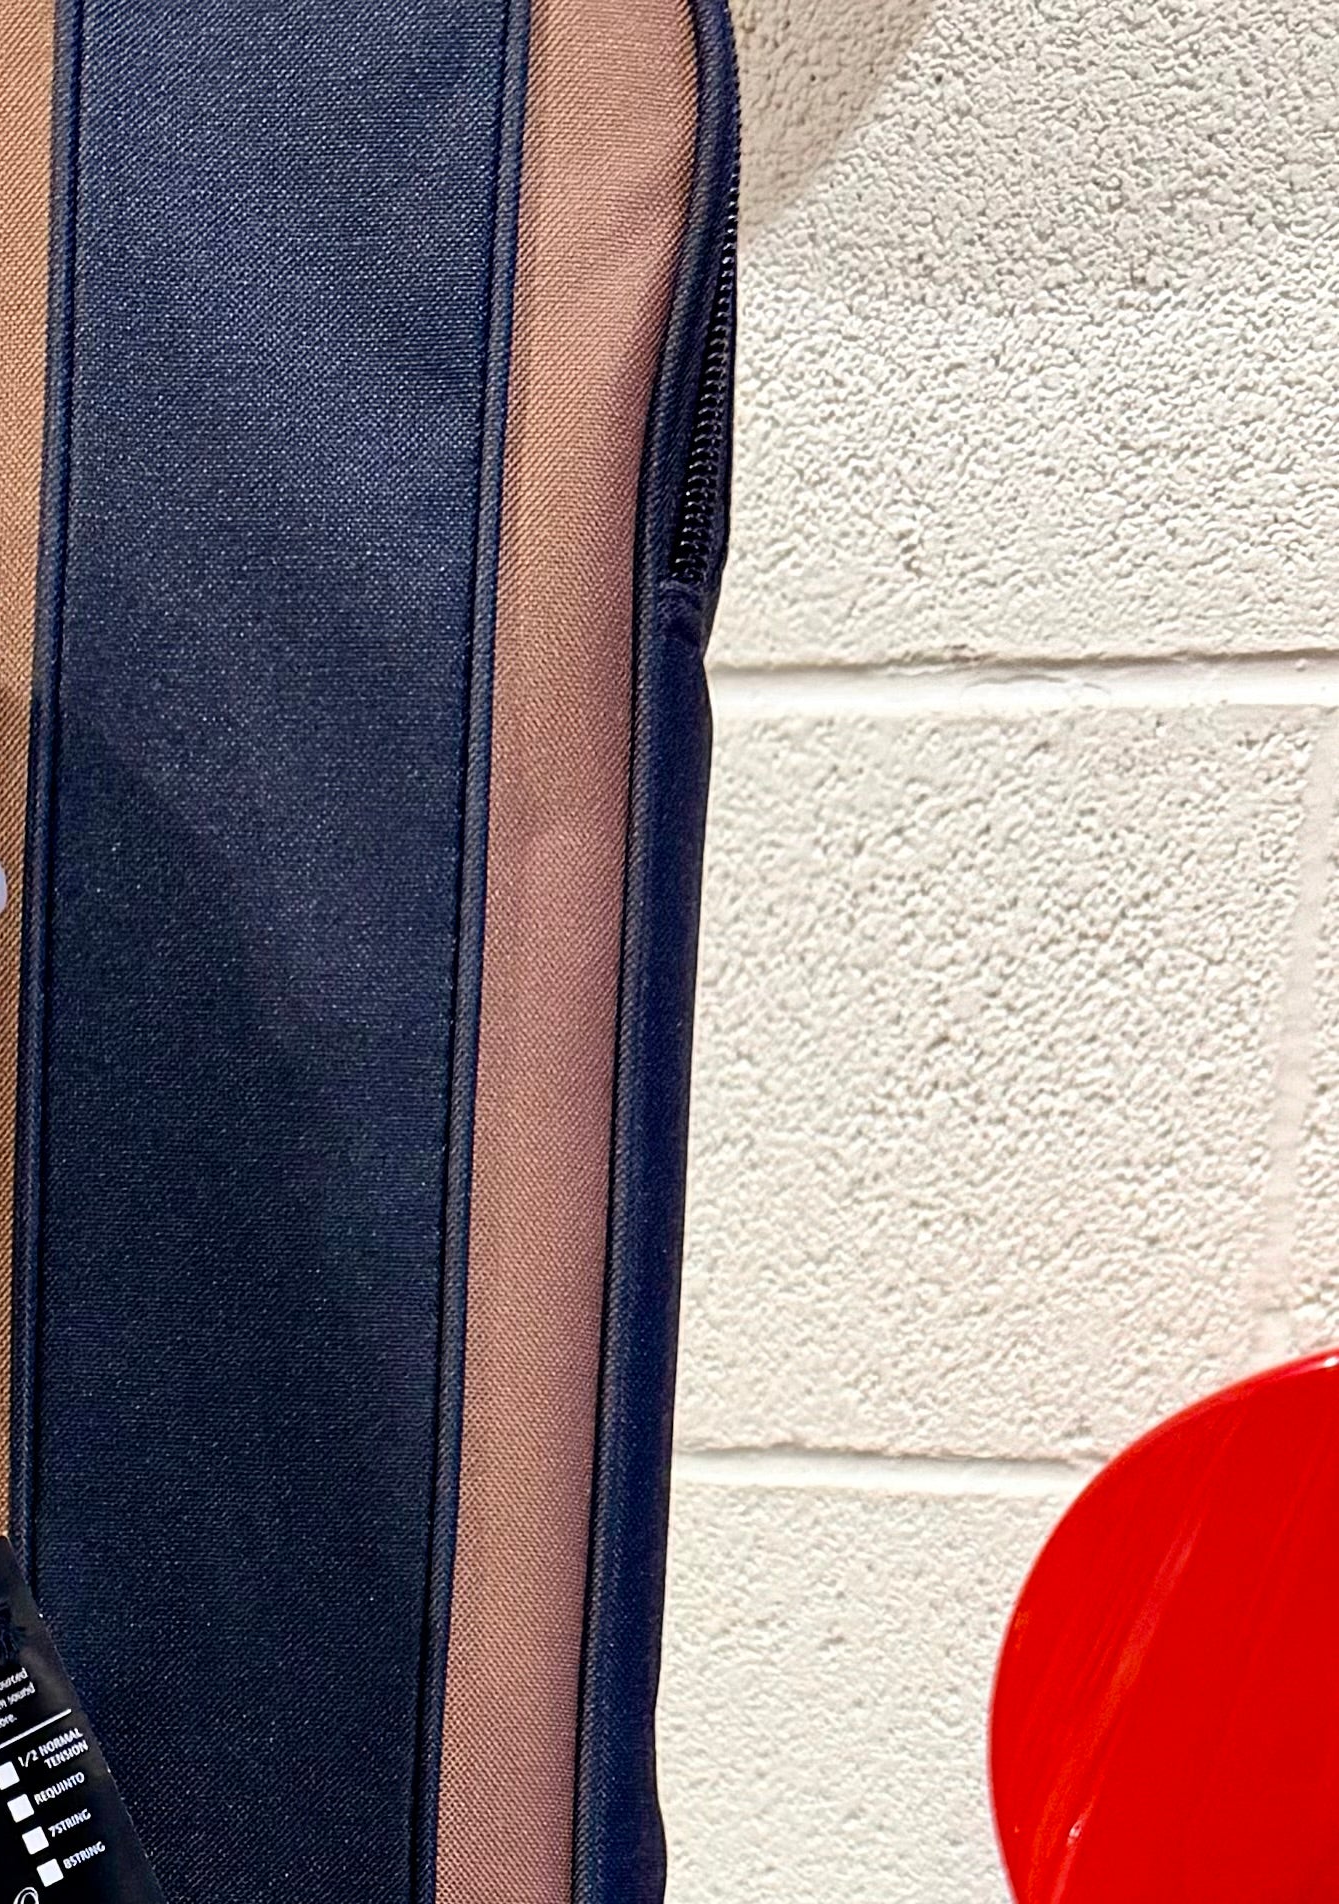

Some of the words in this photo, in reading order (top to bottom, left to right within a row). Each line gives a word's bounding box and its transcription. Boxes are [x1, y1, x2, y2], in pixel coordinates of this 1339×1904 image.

[7, 1681, 36, 1705] sound
[17, 1749, 39, 1768] 1/2
[38, 1727, 84, 1757] NORMAL
[43, 1739, 89, 1769] TENSION
[33, 1771, 85, 1806] REQUINTO
[47, 1808, 92, 1838] 7STRING
